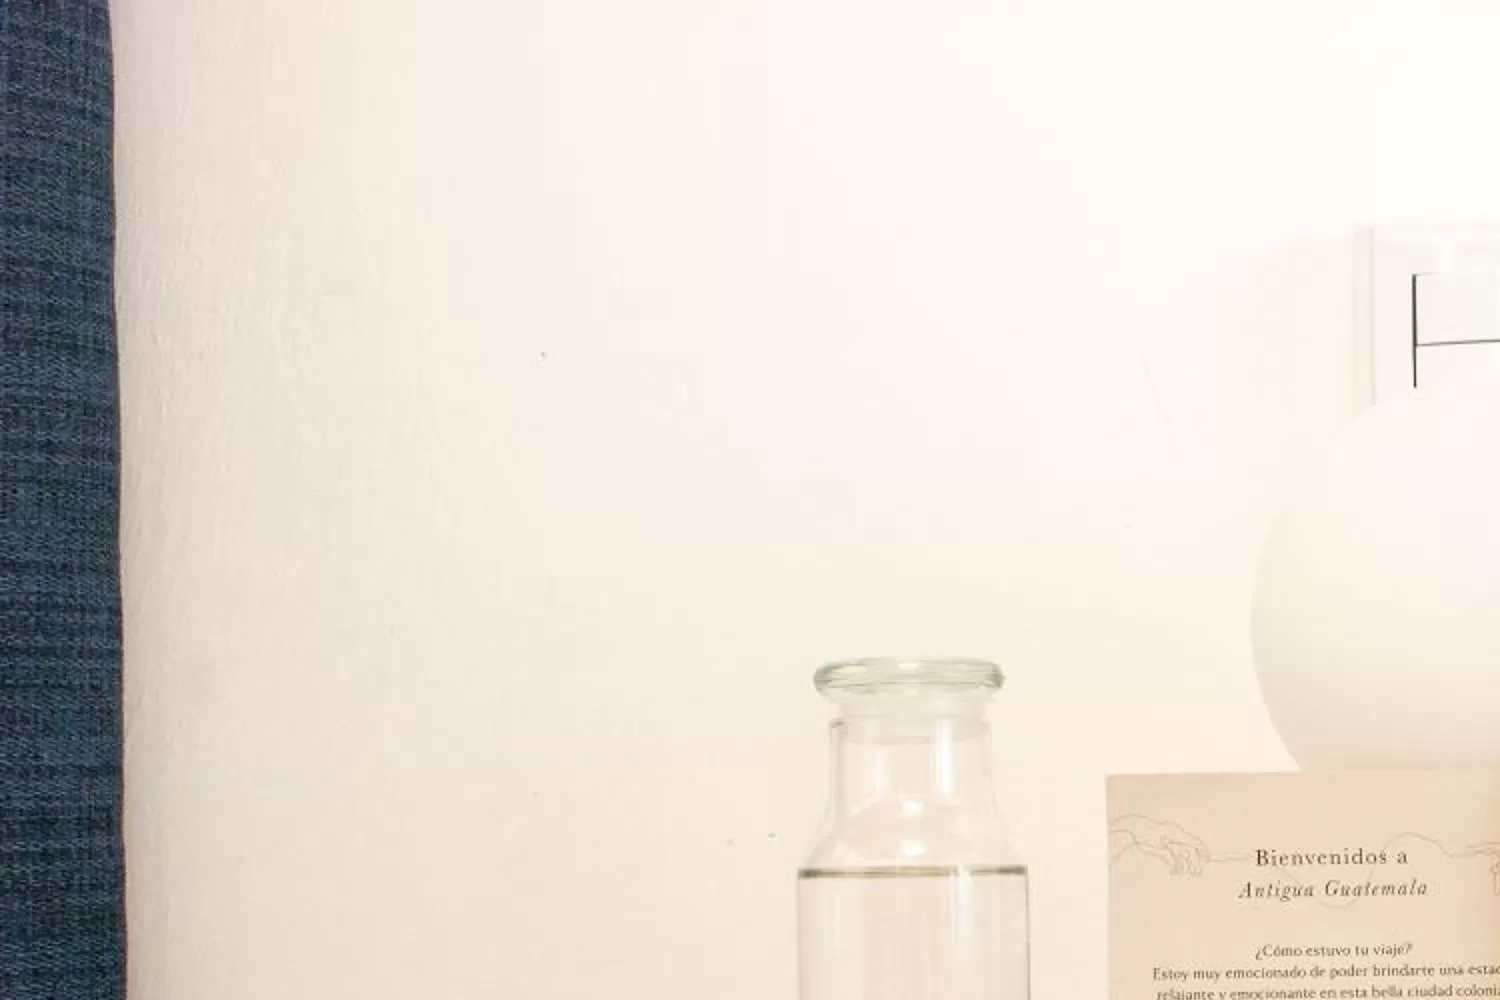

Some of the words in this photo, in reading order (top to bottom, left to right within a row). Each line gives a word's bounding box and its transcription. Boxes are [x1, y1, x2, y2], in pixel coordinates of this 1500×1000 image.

[1255, 848, 1387, 866] Bienvenidos
[1396, 853, 1409, 865] a
[1237, 881, 1314, 902] Antigua
[1324, 880, 1427, 898] Guatemala
[1255, 944, 1303, 961] ¿Cómo
[1304, 943, 1351, 957] estuvo
[1355, 943, 1369, 957] tu
[1373, 942, 1413, 960] viaje?
[1152, 967, 1189, 984] Estoy
[1193, 970, 1221, 984] muy
[1225, 965, 1307, 979] emocionado
[1309, 965, 1326, 979] de
[1329, 964, 1368, 982] poder
[1372, 964, 1435, 978] brindarte
[1439, 966, 1465, 977] una
[1229, 987, 1317, 1000] emocionante
[1319, 990, 1337, 1000] en
[1339, 986, 1368, 1000] esta
[1371, 985, 1403, 999] bella
[1407, 985, 1453, 999] ciudad
